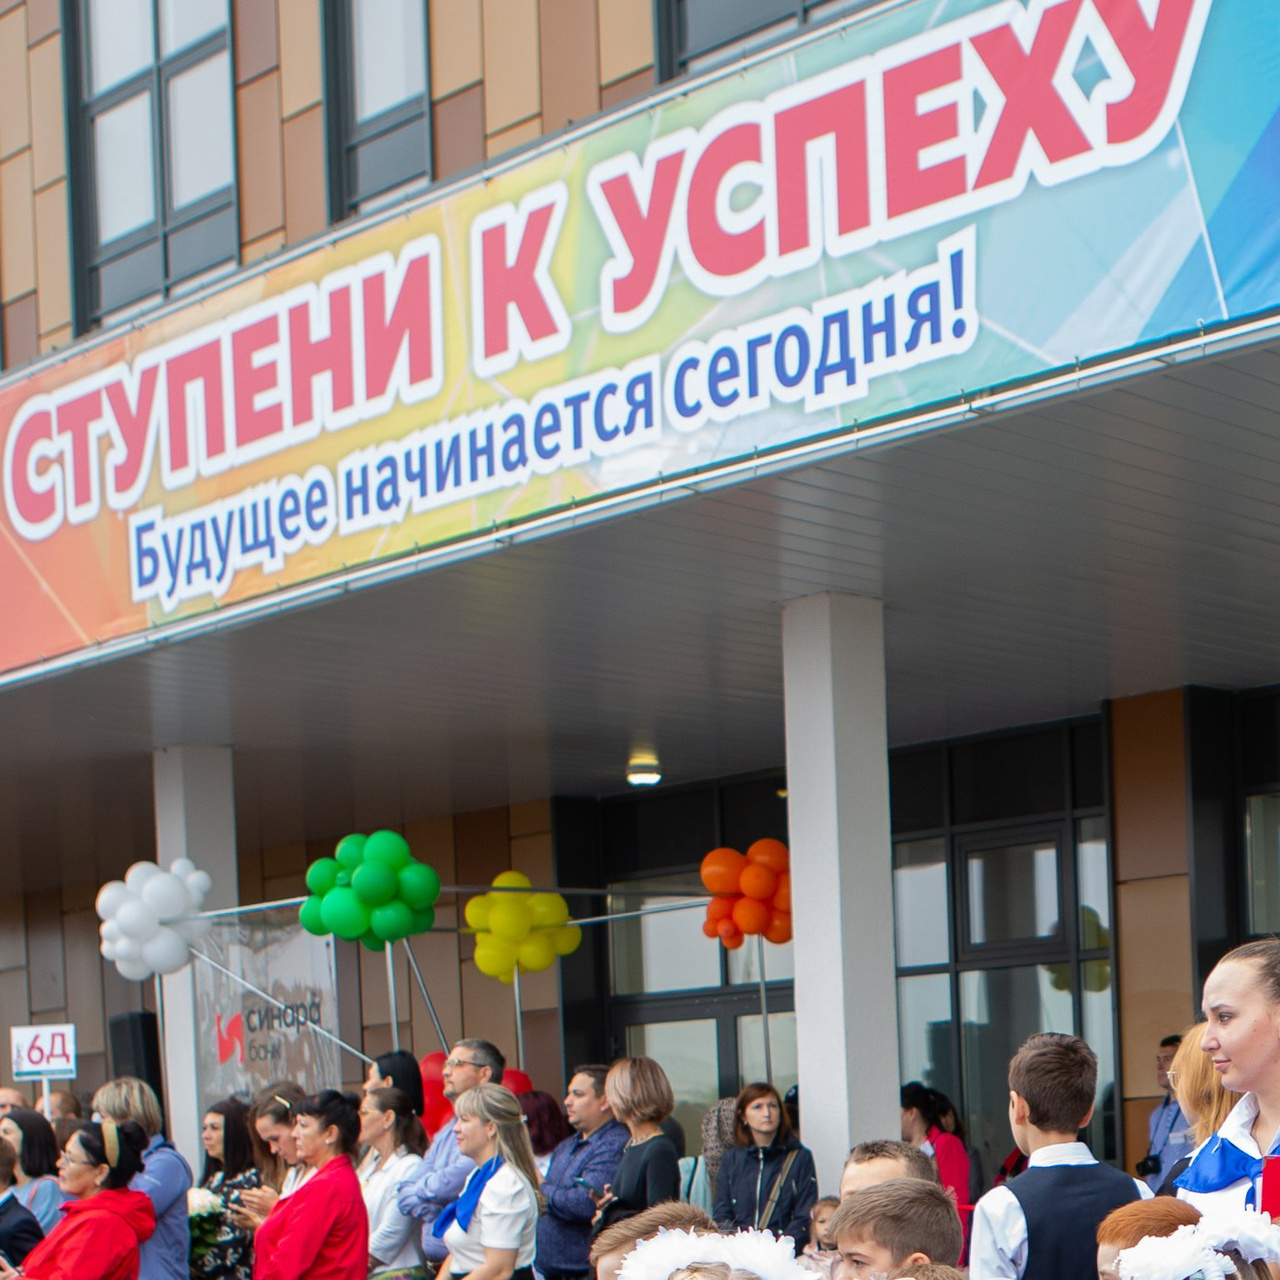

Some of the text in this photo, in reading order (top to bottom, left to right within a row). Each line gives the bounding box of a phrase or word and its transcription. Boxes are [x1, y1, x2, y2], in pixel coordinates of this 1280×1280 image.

[11, 0, 1195, 523] СТУПЕНИ К УСПЕХУ
[135, 249, 965, 596] Будущее начинается сегодня!
[27, 1033, 70, 1065] 6Д
